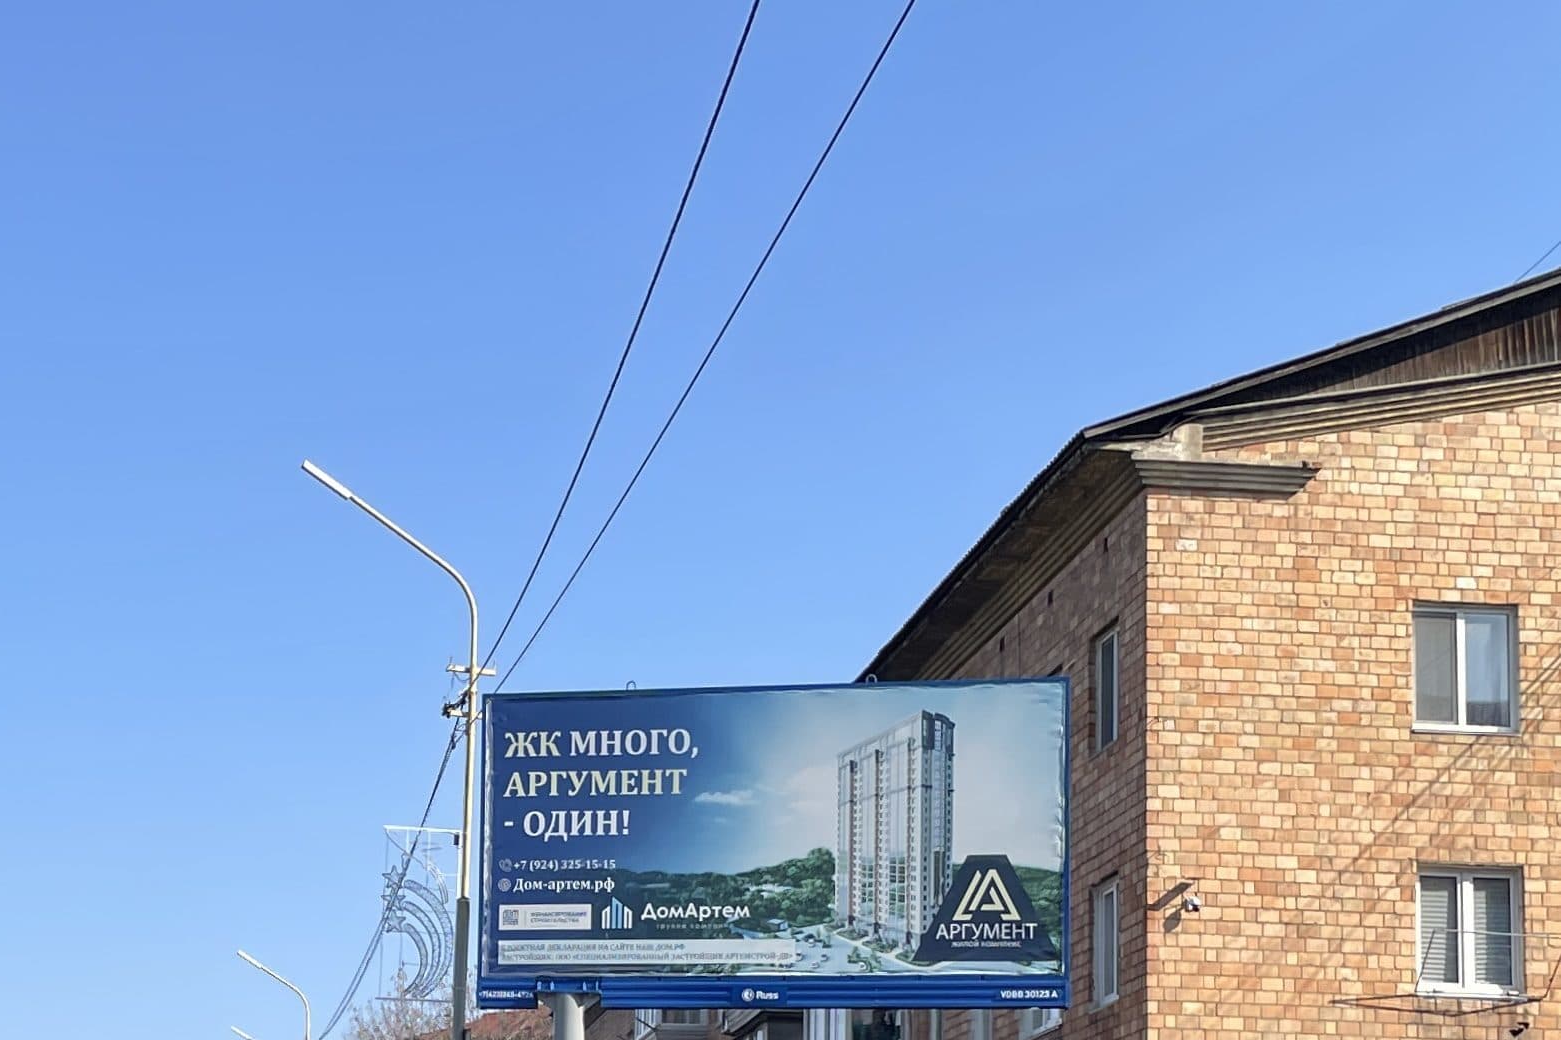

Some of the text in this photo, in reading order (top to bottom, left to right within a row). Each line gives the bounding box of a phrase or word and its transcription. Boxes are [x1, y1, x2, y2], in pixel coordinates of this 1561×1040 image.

[504, 728, 699, 758] ЖК МНОГО,
[503, 769, 687, 797] АРГУМЕНТ
[523, 810, 630, 842] ОДИН!
[513, 859, 616, 872] +7 (924) 325-15-15
[512, 876, 615, 893] Дом-артем.рф
[641, 902, 751, 921] ДомАртем
[936, 923, 1038, 940] АРГУМЕНТ
[756, 991, 779, 1000] Russ
